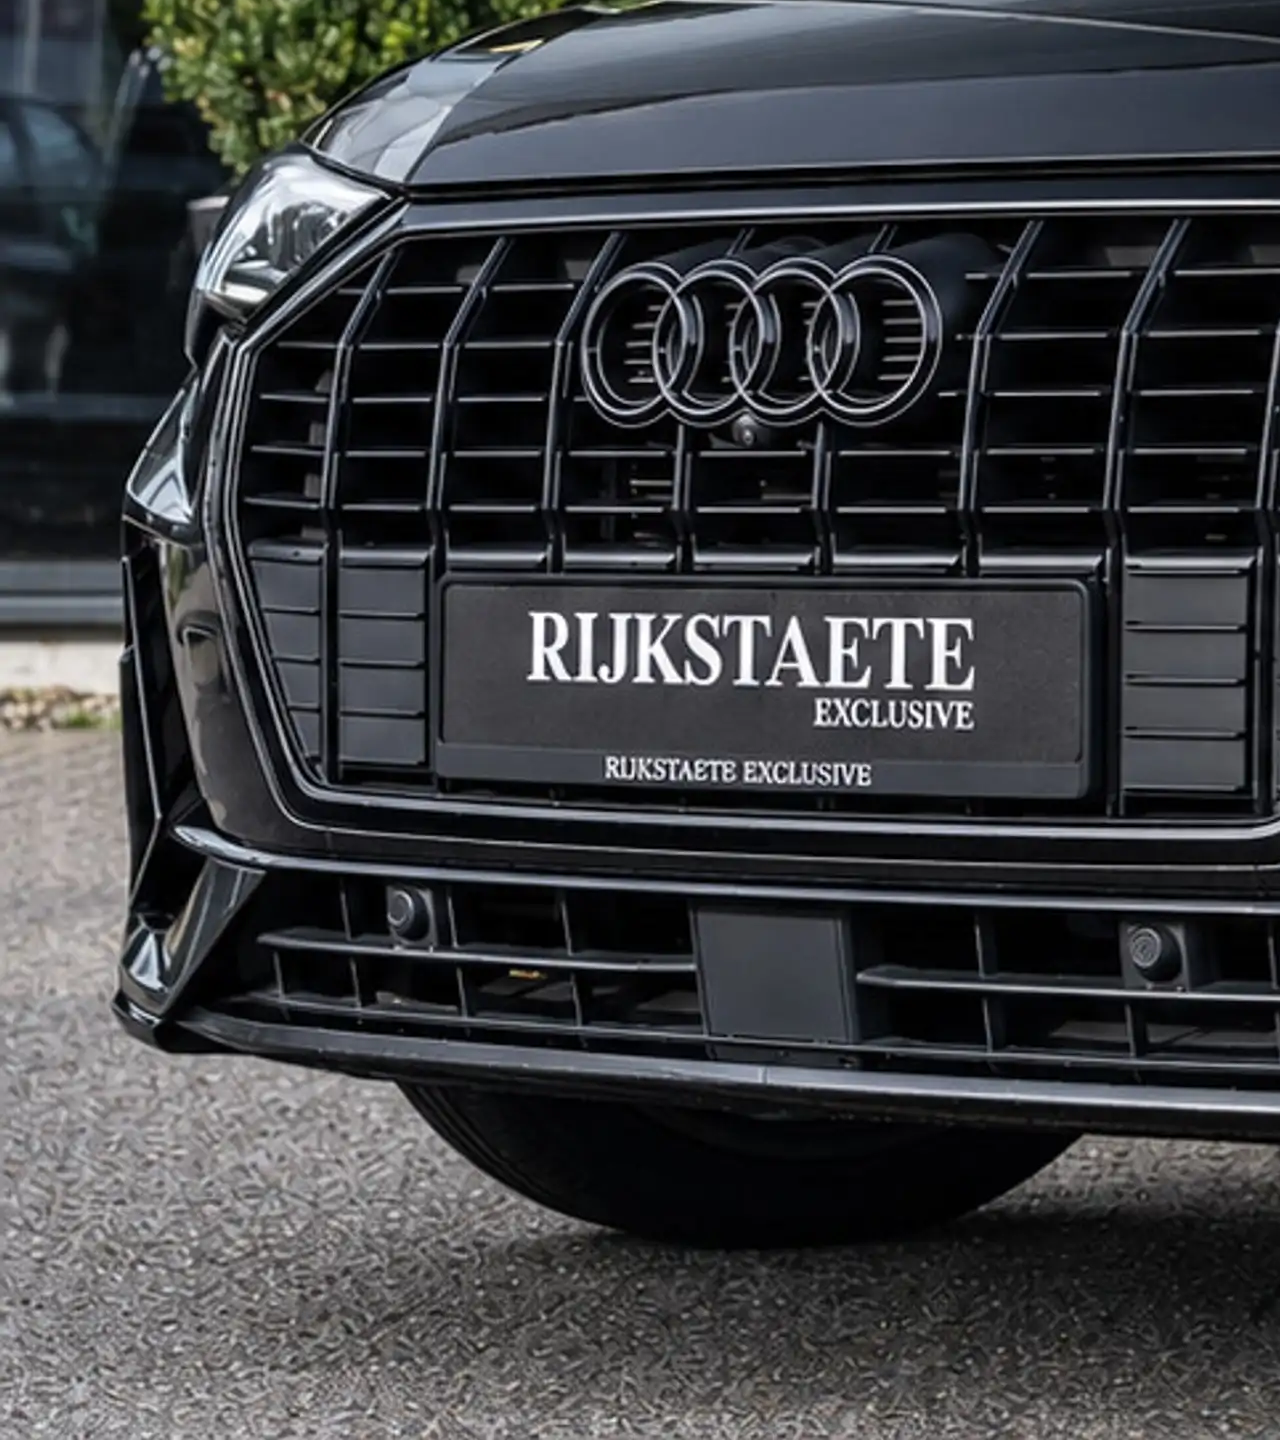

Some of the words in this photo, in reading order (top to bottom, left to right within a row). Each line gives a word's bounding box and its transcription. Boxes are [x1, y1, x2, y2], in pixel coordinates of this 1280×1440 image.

[526, 610, 976, 692] RIJKSTAETE
[813, 697, 975, 730] EXCLUSIVE
[604, 755, 737, 783] RIJKSTAETE
[743, 760, 872, 787] EXCLUSIVE
